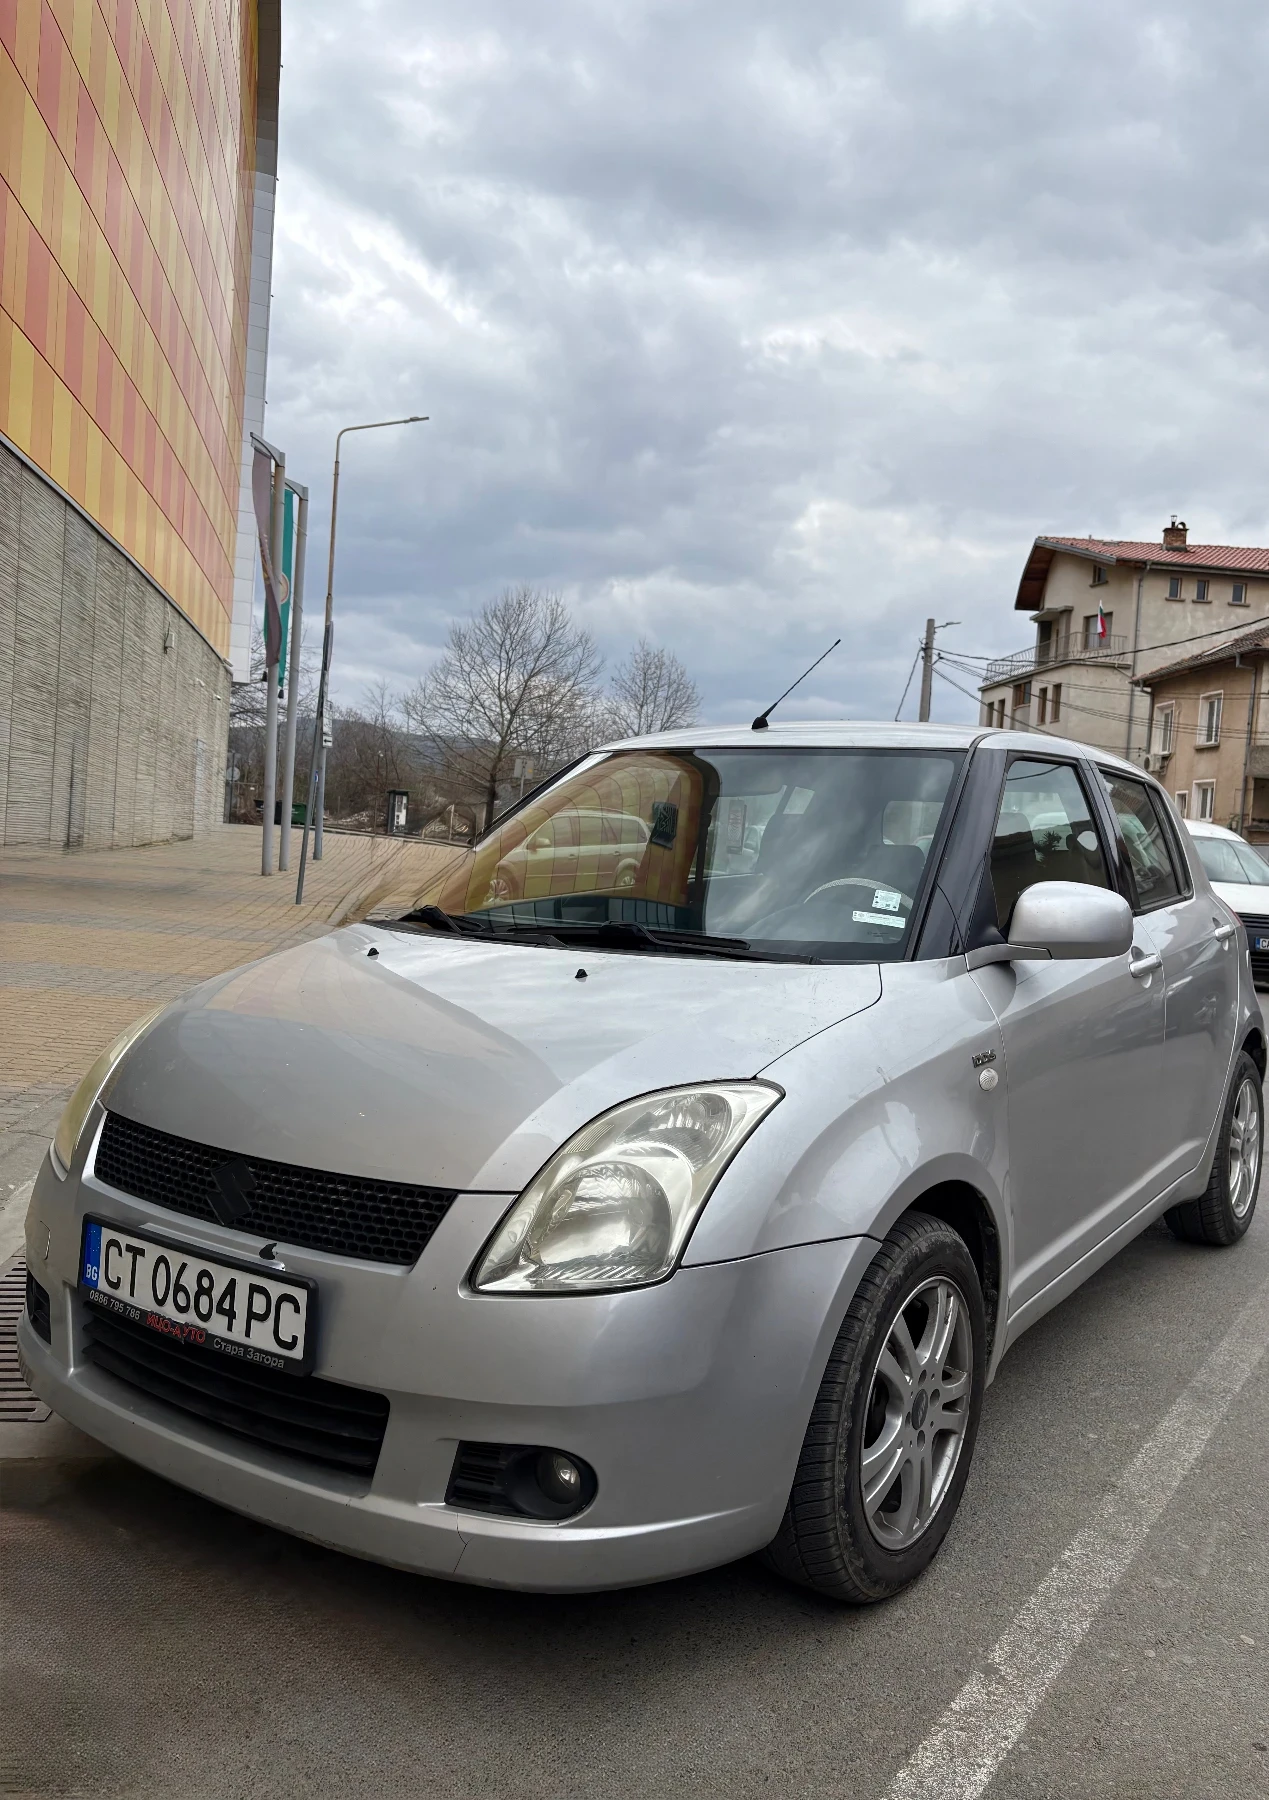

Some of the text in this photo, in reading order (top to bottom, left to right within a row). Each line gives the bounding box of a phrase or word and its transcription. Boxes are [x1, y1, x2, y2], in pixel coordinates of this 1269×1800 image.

[85, 1263, 98, 1281] BG
[151, 1254, 237, 1332] 0684
[109, 1298, 124, 1313] 795
[125, 1305, 141, 1320] 786
[213, 1337, 245, 1356] Стара
[246, 1347, 285, 1369] Загора
